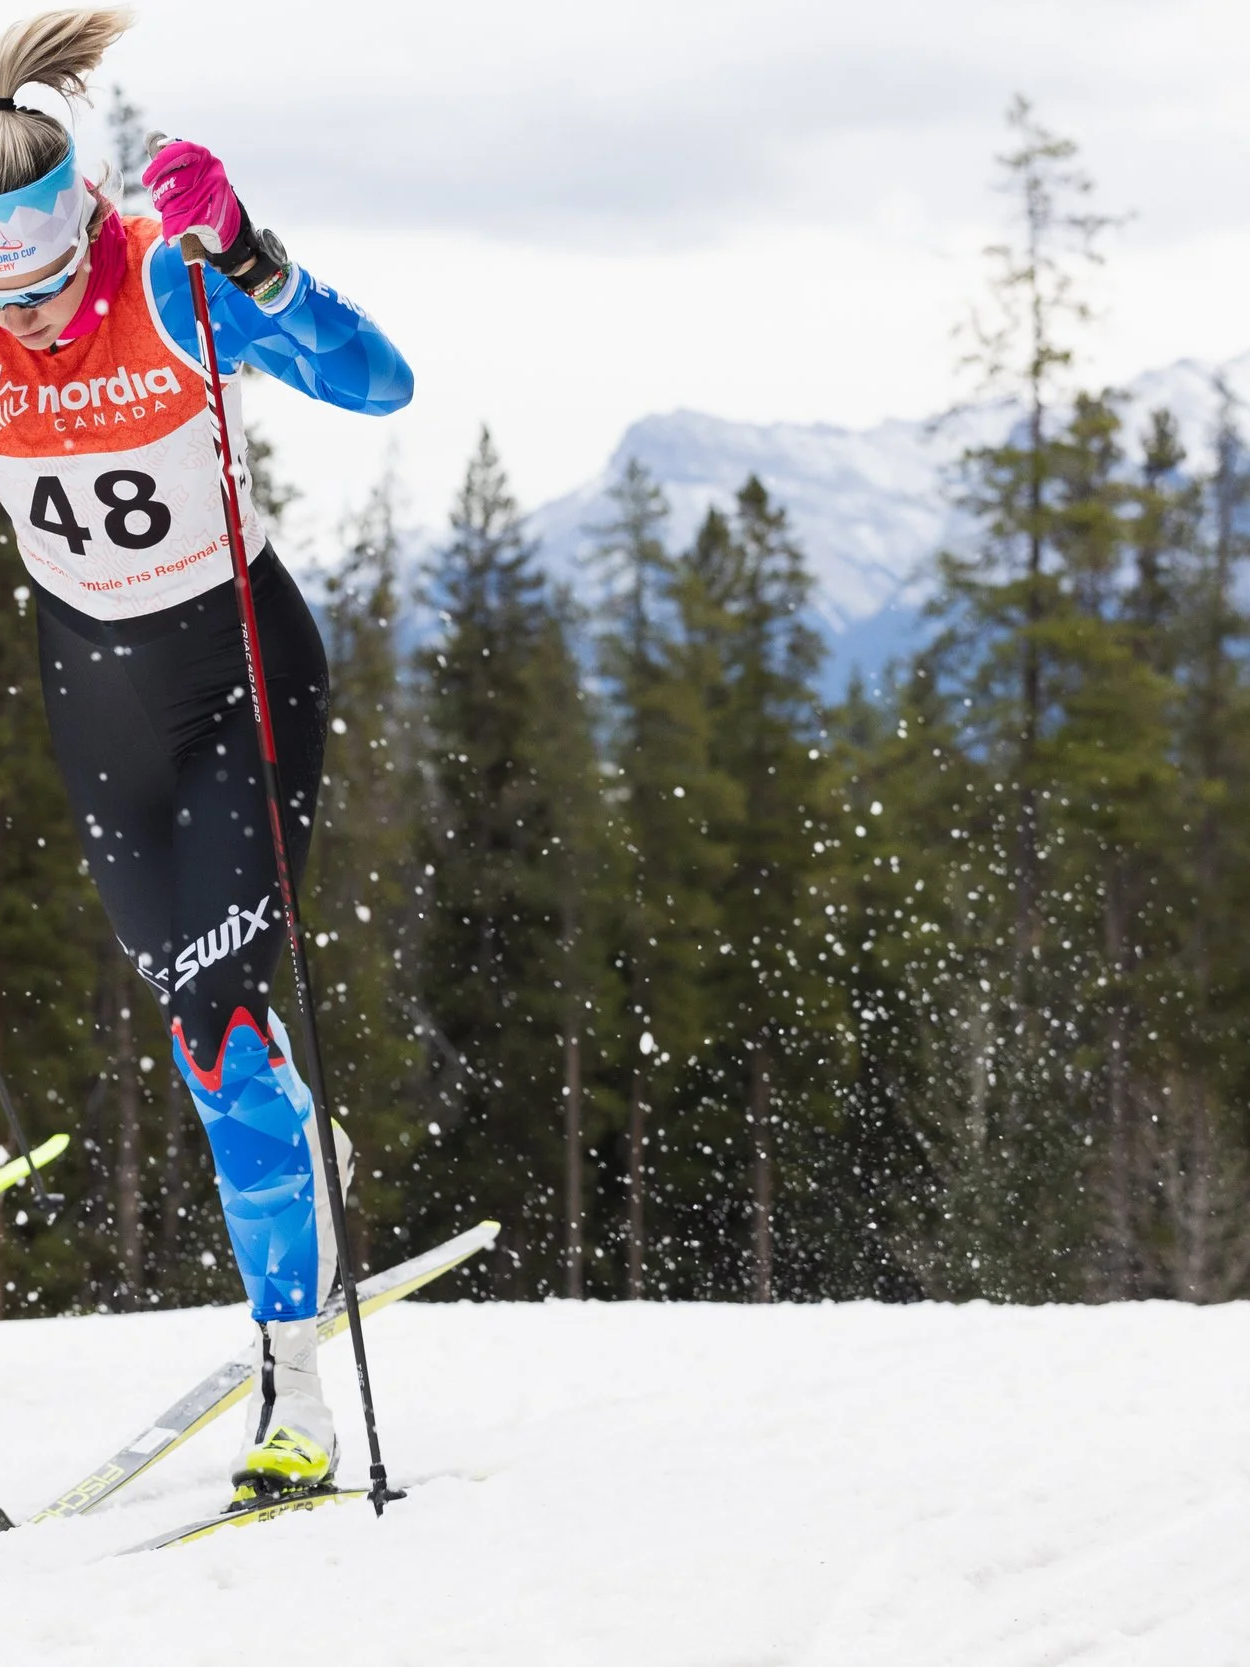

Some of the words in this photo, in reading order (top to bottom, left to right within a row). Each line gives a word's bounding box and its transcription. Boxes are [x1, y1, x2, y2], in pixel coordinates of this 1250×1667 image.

[21, 246, 37, 258] CUP
[54, 400, 167, 433] CANADA
[29, 470, 172, 556] 48
[127, 571, 151, 586] FIS
[154, 541, 218, 577] Regional
[240, 622, 252, 662] TRIAC
[250, 683, 261, 723] AERO
[174, 895, 270, 992] swix
[28, 1463, 125, 1525] FISCH
